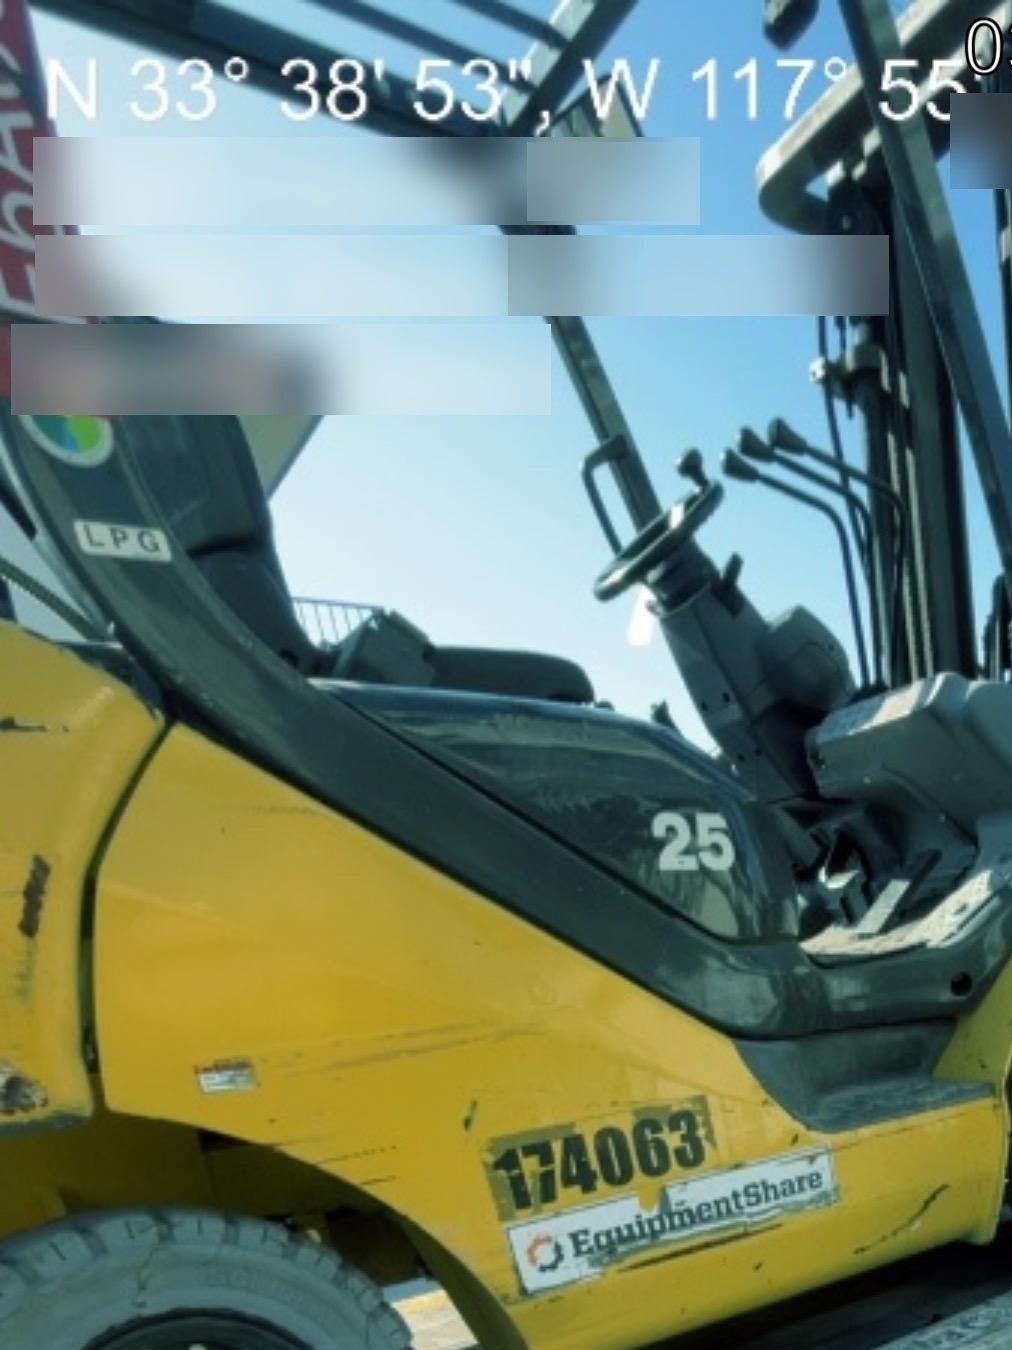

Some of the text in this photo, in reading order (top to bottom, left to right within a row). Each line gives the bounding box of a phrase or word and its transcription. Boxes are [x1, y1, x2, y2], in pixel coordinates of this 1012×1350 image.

[83, 524, 161, 553] LPG
[651, 812, 736, 871] 25
[493, 1108, 706, 1211] 174063
[567, 1167, 824, 1259] EquipmentShare
